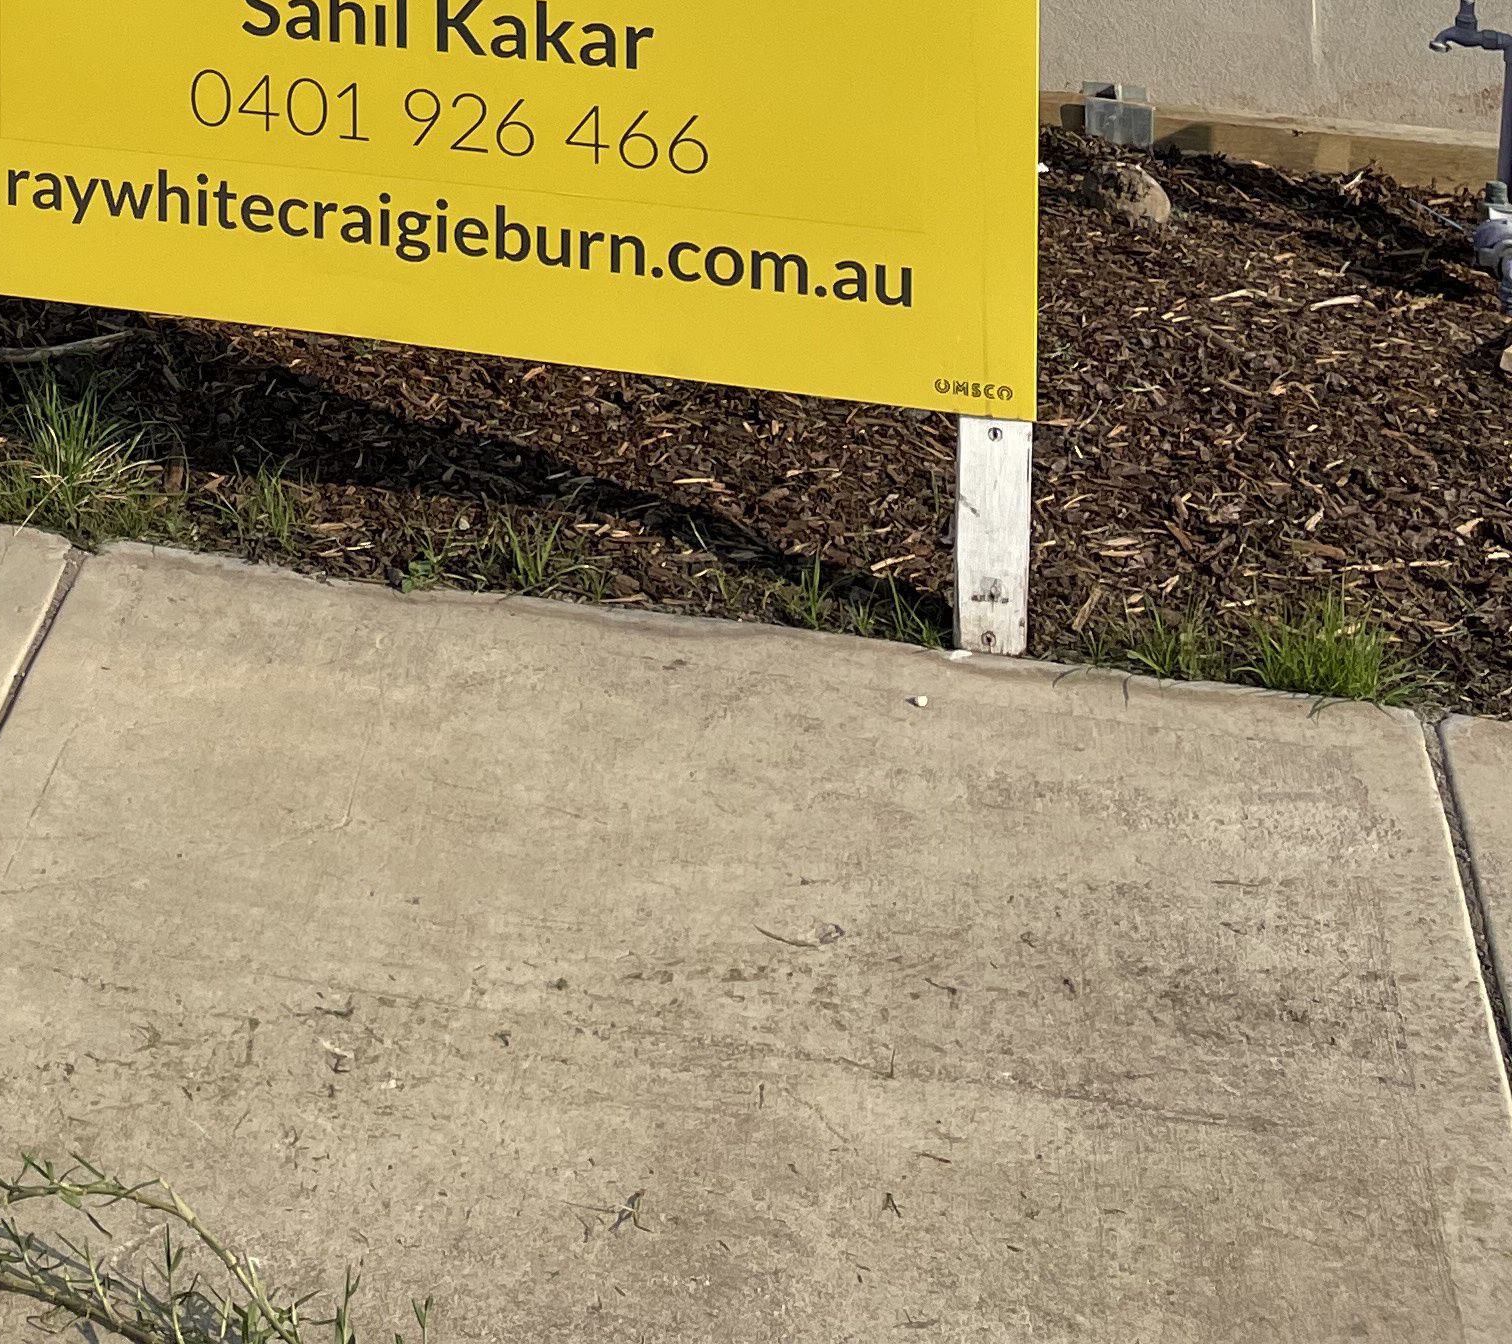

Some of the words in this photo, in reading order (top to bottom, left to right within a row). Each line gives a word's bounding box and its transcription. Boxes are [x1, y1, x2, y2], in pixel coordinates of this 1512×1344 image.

[190, 68, 370, 143] 0401
[404, 87, 535, 158] 926
[564, 104, 710, 175] 466
[6, 167, 914, 308] raywhitecraigieburn.com.au
